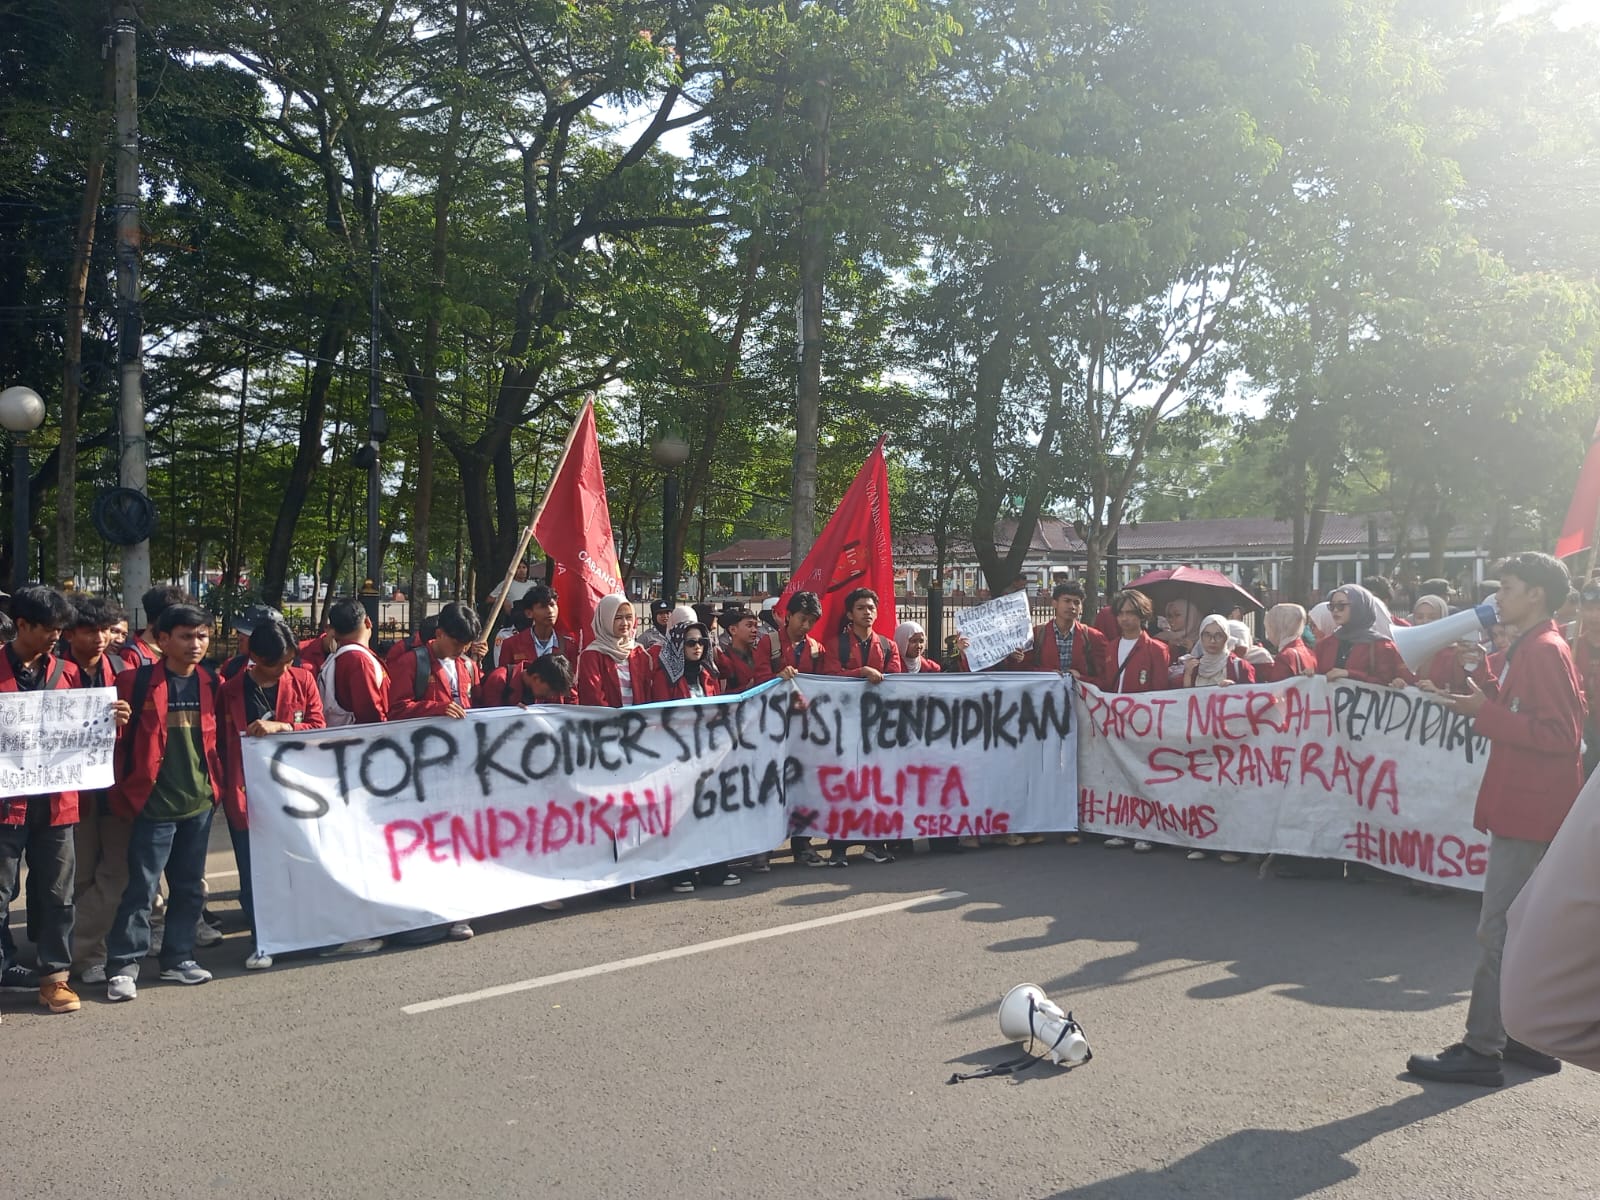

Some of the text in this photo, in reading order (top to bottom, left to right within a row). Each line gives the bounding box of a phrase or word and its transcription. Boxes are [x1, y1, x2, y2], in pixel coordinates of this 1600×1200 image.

[578, 551, 617, 588] CABANG
[0, 695, 76, 728] OLAK
[1081, 685, 1178, 740] RAPOT
[1186, 686, 1332, 744] MERAH
[270, 726, 458, 819] STOP
[860, 688, 1071, 754] PENDIDIKAN
[1144, 742, 1398, 816] SERANG RAYA
[384, 756, 969, 881] PENDIDIKAN GELAP GULITA
[825, 808, 1009, 838] IMM SERANG
[1079, 788, 1218, 839] #HARDIKNAS
